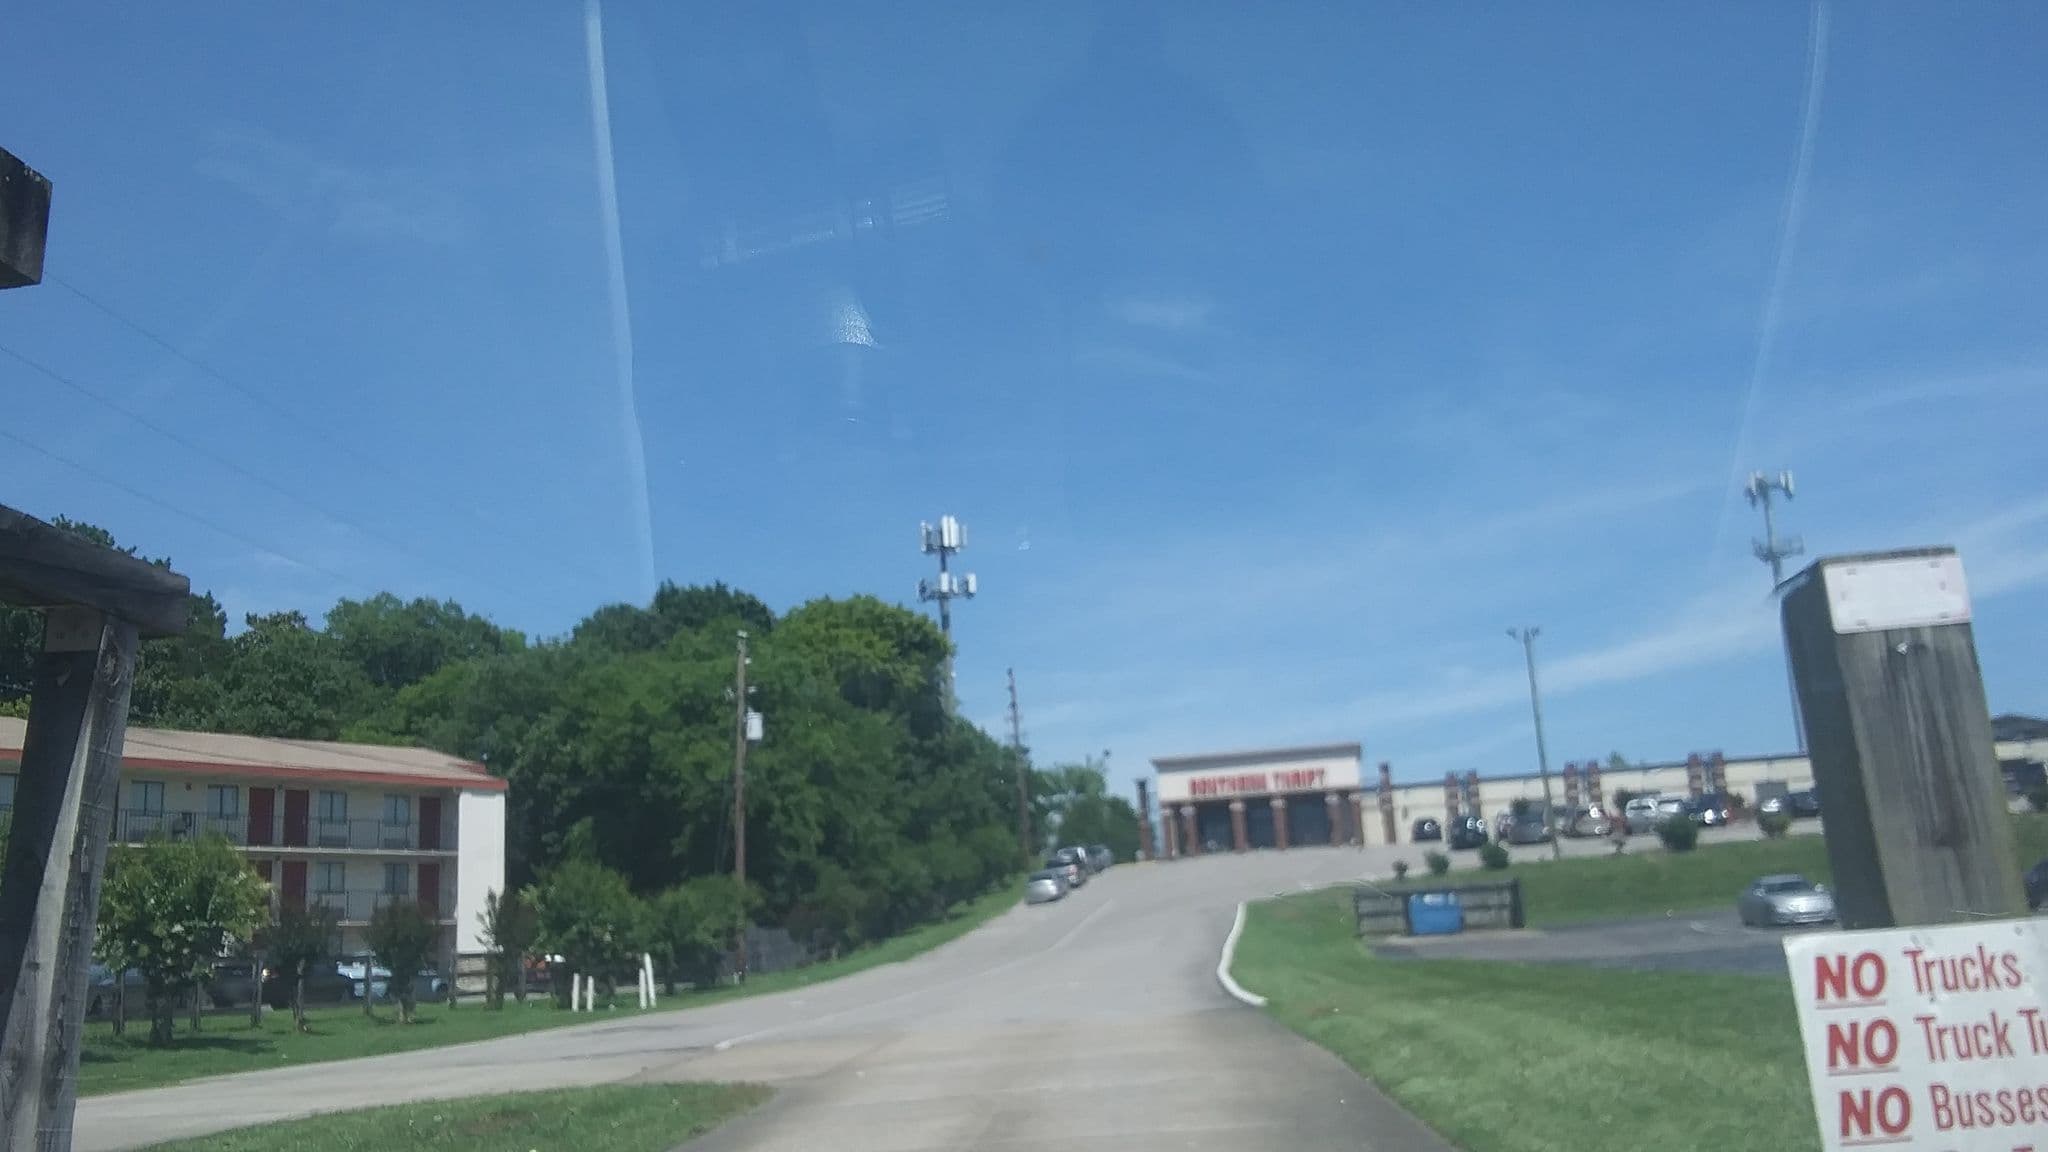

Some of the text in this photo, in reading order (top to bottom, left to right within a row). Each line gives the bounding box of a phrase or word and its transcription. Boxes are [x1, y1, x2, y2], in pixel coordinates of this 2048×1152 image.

[1272, 768, 1325, 790] TIT
[1815, 945, 2022, 999] NO Trucks
[1827, 1019, 1898, 1067] NO
[1913, 1010, 2014, 1062] Truck
[1840, 1083, 2048, 1136] NO Busses
